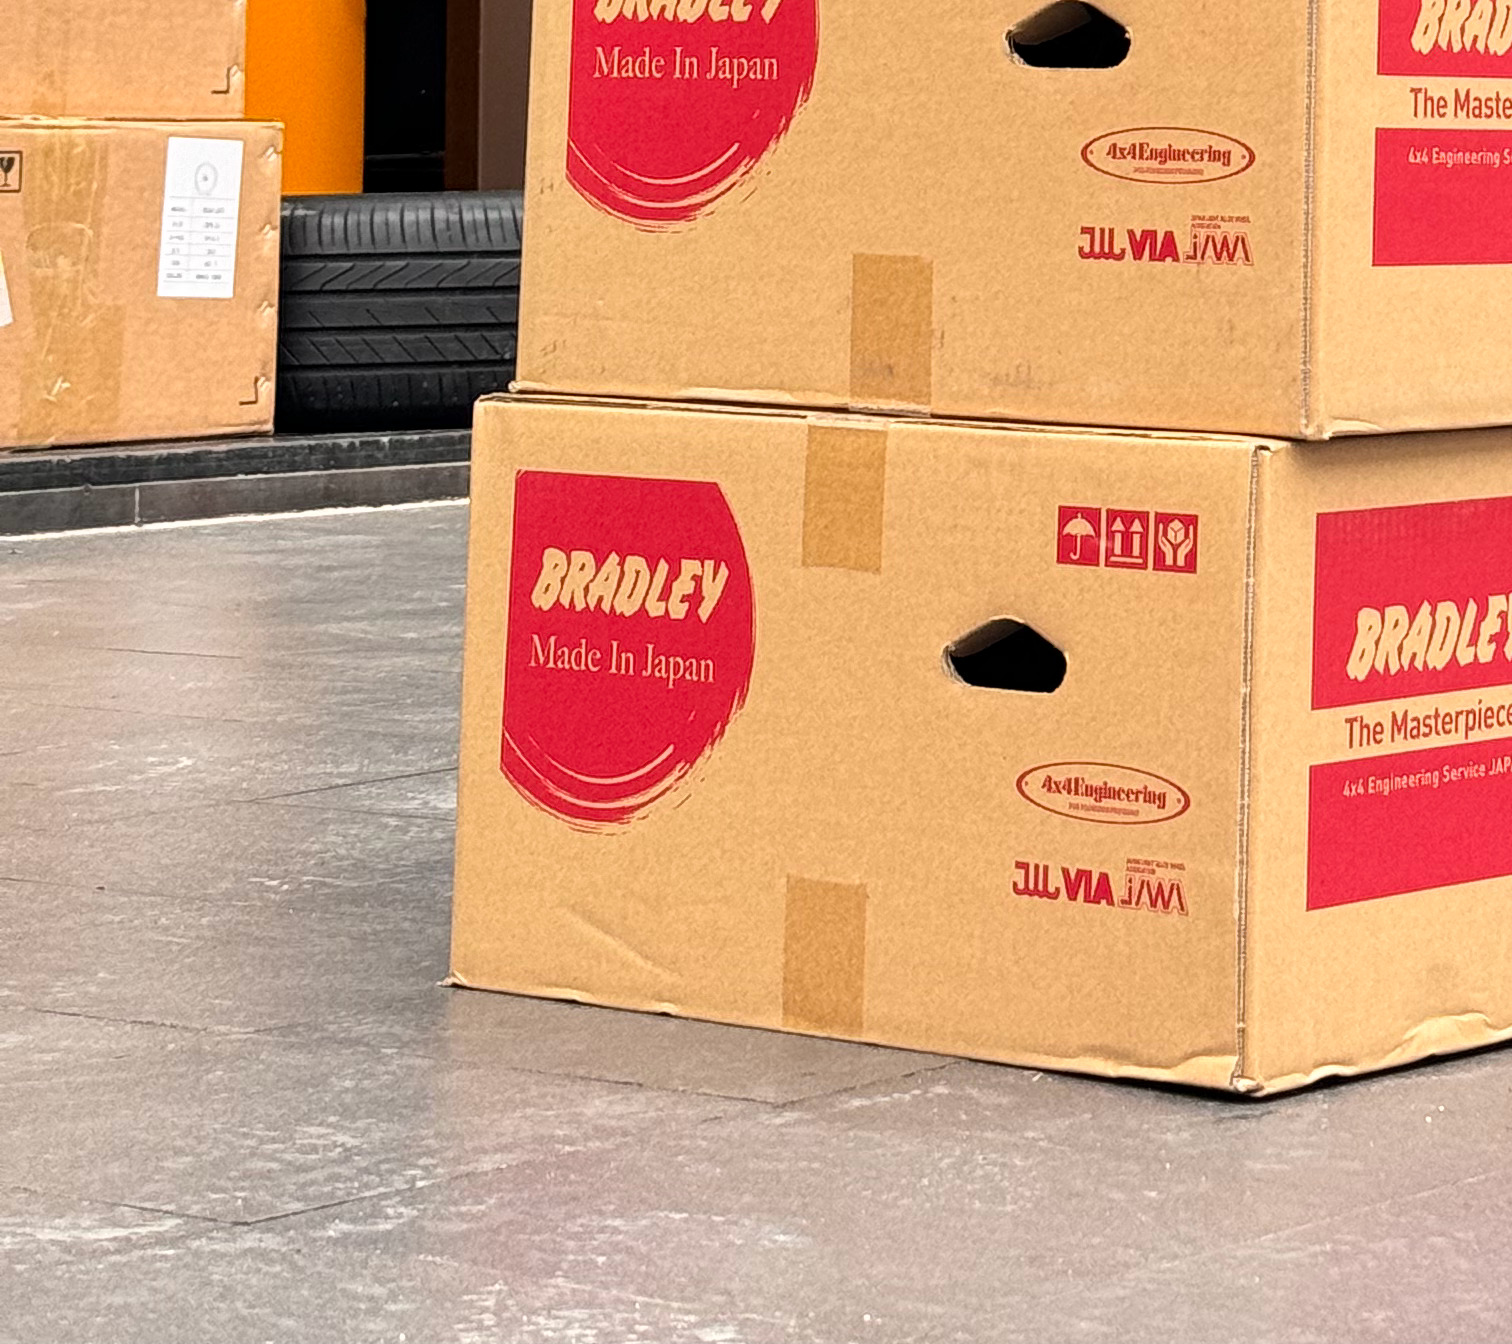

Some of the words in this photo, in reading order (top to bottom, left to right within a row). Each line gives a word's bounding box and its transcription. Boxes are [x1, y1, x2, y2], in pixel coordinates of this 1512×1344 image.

[593, 46, 665, 79] Made
[673, 46, 698, 80] In
[706, 47, 778, 88] Japan
[1410, 87, 1447, 118] The
[1408, 147, 1428, 164] 4x4
[1432, 147, 1500, 168] Engineering
[1127, 229, 1180, 262] VIA
[531, 547, 729, 624] BRADLEY
[528, 634, 601, 671] Made
[609, 640, 634, 675] In
[642, 644, 714, 688] Japan
[1345, 715, 1383, 749] The
[1343, 779, 1364, 798] 4x4
[1368, 768, 1439, 795] Engineering
[1442, 762, 1486, 783] Service
[1061, 866, 1114, 907] VIA
